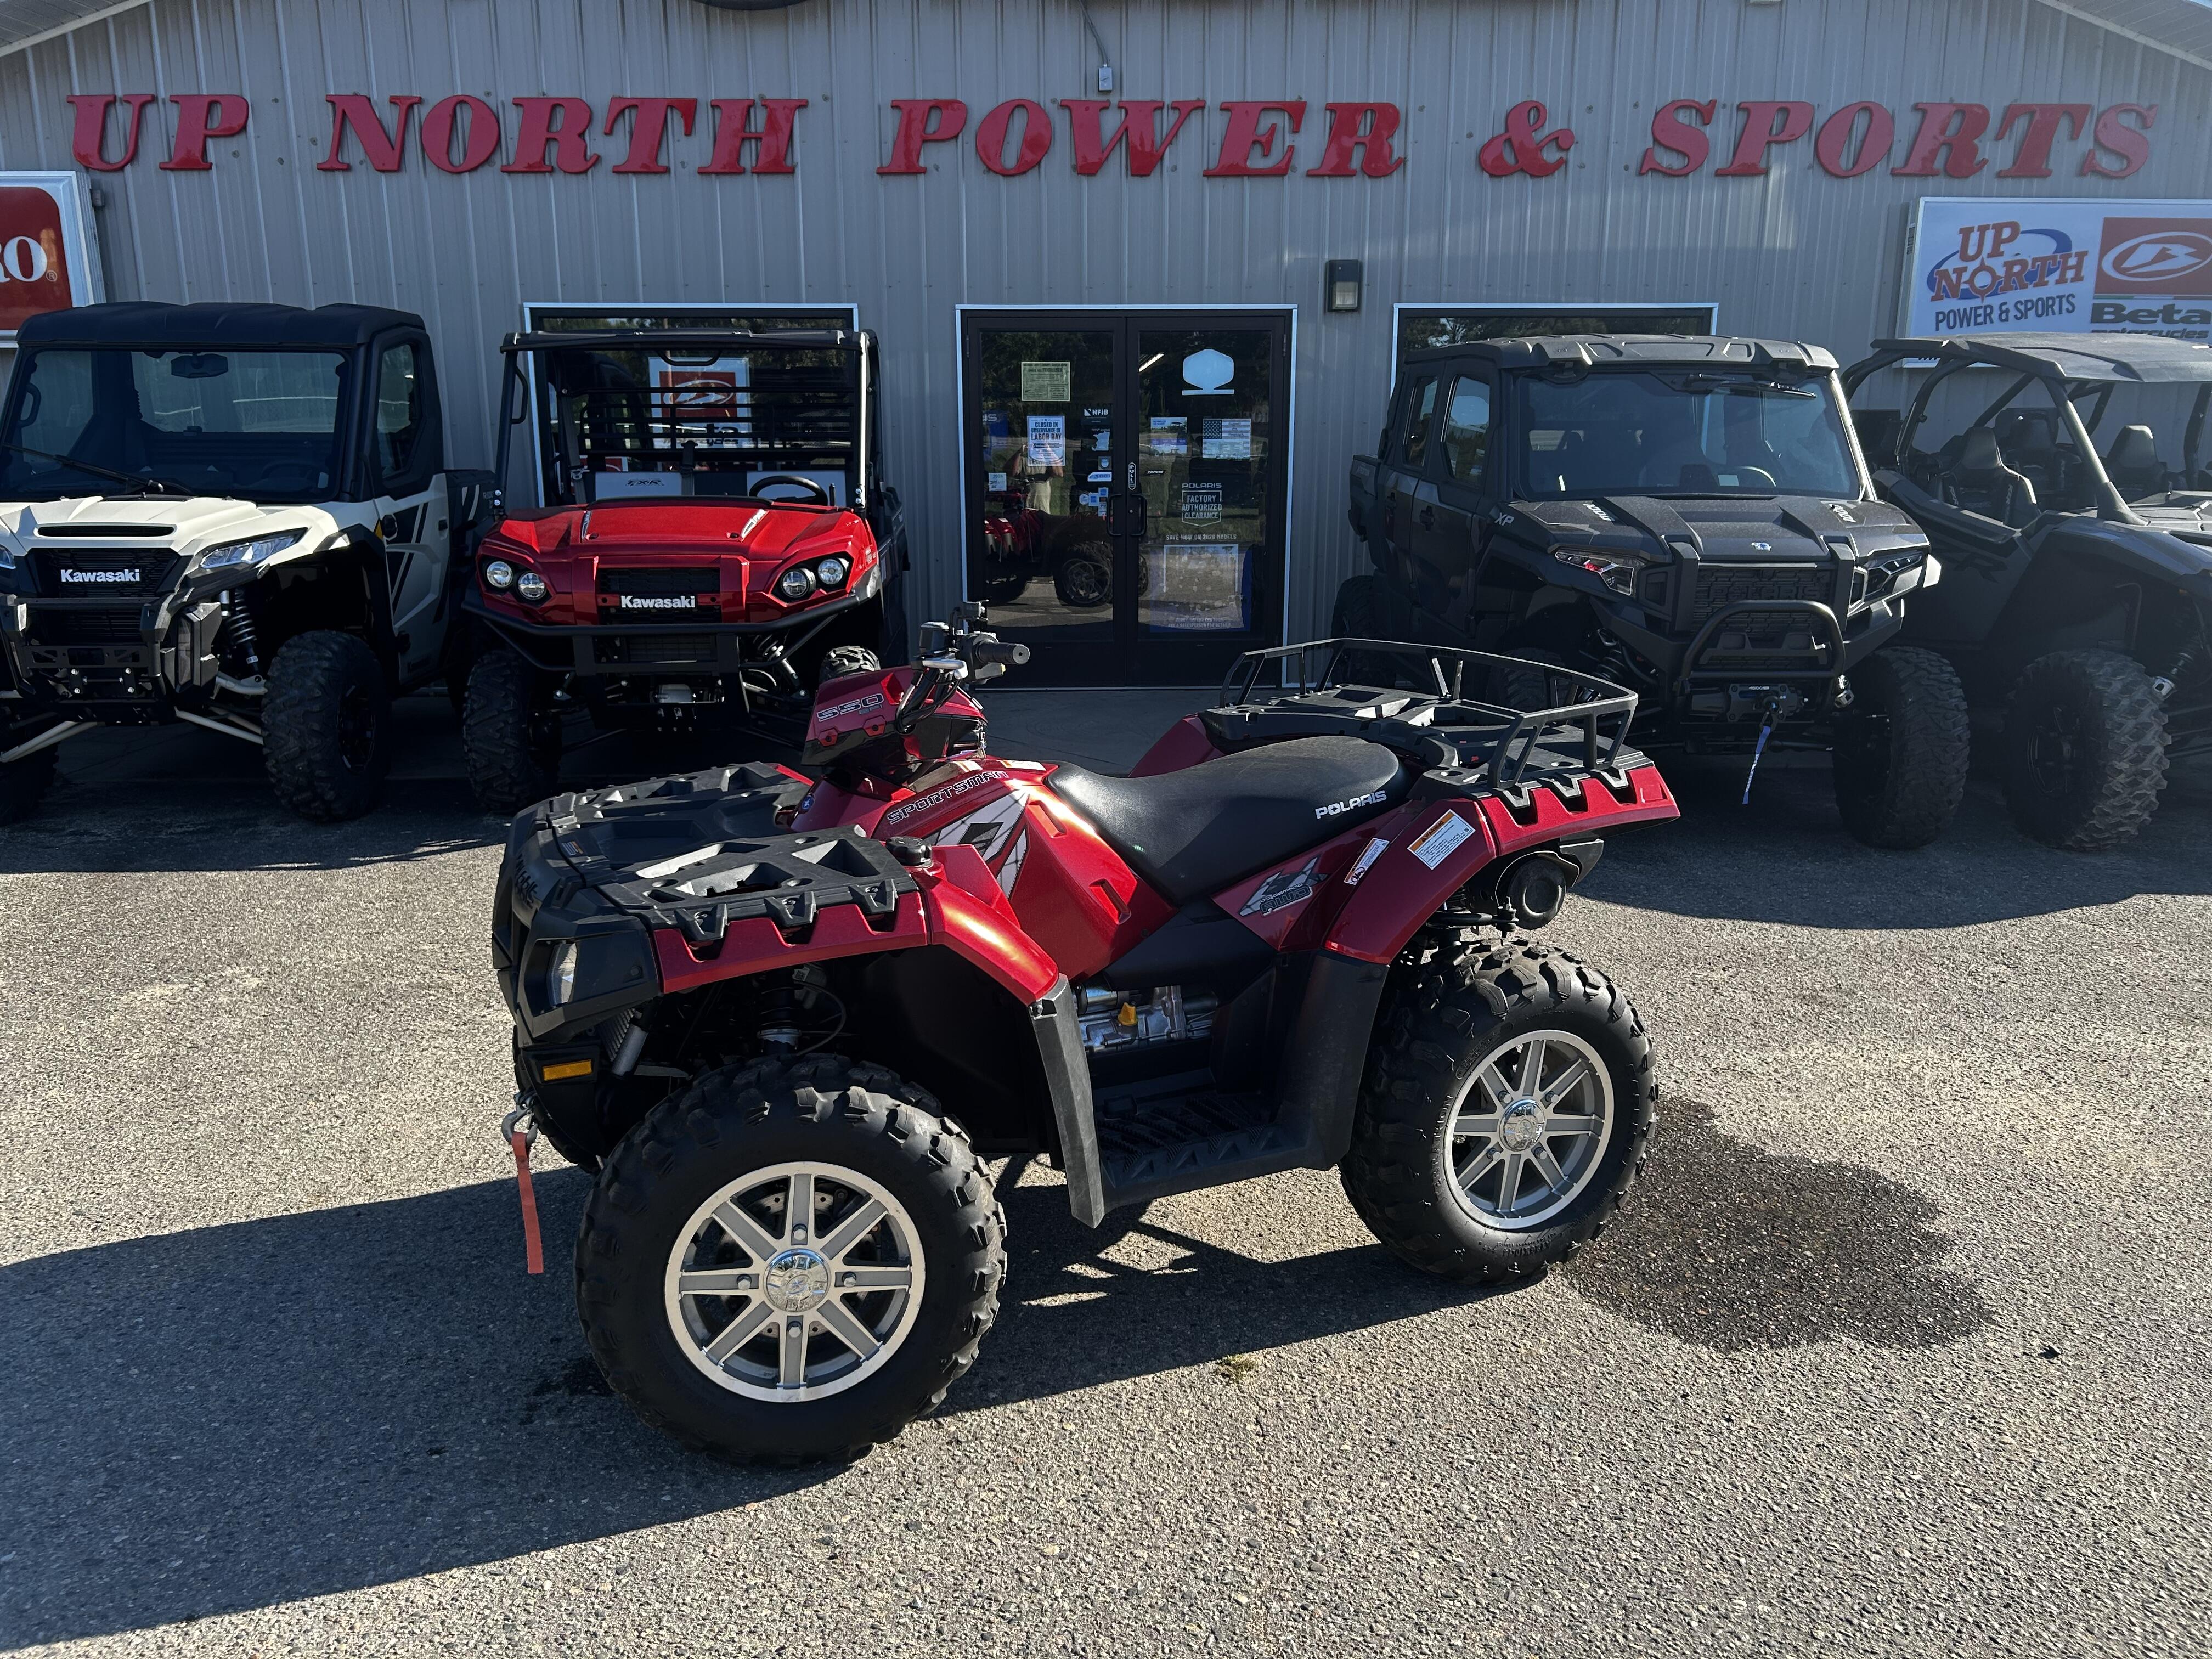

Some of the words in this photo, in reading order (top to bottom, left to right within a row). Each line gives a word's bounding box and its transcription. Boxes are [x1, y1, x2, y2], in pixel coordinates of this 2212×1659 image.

[66, 94, 250, 171] UP
[317, 94, 808, 174] NORTH
[877, 98, 1404, 177] POWER
[1479, 100, 1575, 177] &
[1638, 99, 2159, 179] SPORTS
[1958, 220, 2021, 262] UP
[1931, 251, 2089, 303] NORTH
[1936, 303, 1994, 331] POWER
[1999, 301, 2009, 323] &
[2014, 292, 2076, 321] SPORTS
[2091, 303, 2212, 324] Beta
[1494, 512, 1515, 526] XP
[61, 568, 140, 582] Kawasaki
[620, 595, 696, 608] Kawasaki
[817, 693, 884, 722] 550
[887, 771, 1009, 825] SPORTSMAN
[1315, 790, 1387, 819] POLARIS
[1425, 821, 1444, 838] WARNING
[1260, 885, 1312, 915] AWD
[1273, 882, 1304, 898] DEMAND
